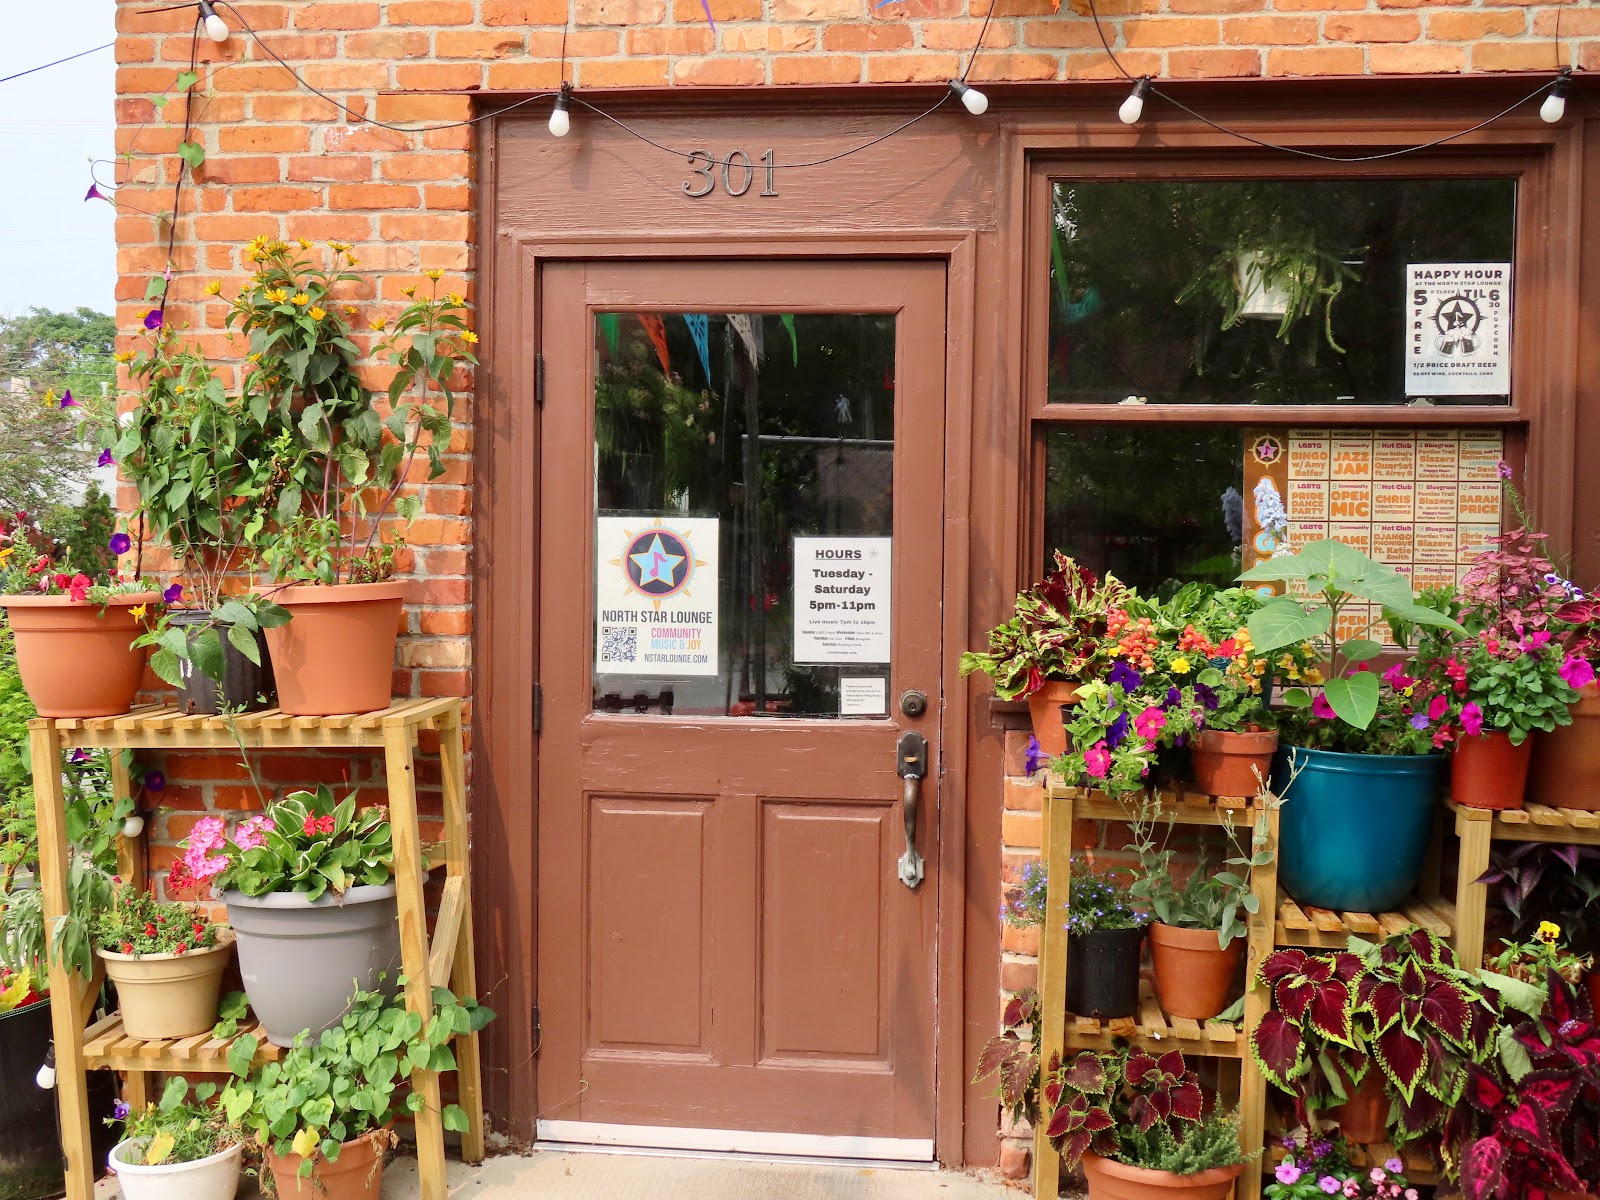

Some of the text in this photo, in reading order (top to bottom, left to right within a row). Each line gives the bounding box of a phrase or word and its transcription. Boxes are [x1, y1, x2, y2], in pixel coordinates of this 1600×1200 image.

[682, 148, 779, 197] 301
[1414, 270, 1502, 279] HAPPY HOUR
[1414, 290, 1427, 305] 5
[1464, 289, 1486, 298] TIL
[1489, 289, 1500, 301] 6
[1414, 310, 1422, 354] FREE
[1292, 452, 1328, 460] BINGO
[1334, 452, 1369, 462] JAZZ
[1334, 463, 1368, 475] JAM
[1292, 492, 1324, 500] PRIDE
[1331, 491, 1369, 500] OPEN
[1375, 494, 1411, 503] CHRIS
[1460, 495, 1498, 503] SARAH
[1331, 502, 1369, 517] MIC
[1460, 504, 1498, 514] PRICE
[1290, 533, 1324, 541] INTER
[815, 550, 862, 559] HOURS
[812, 569, 865, 580] Tuesday
[814, 585, 871, 596] Saturday
[809, 601, 875, 612] 5pm-11pm
[602, 610, 712, 624] NORTH STAR LOUNGE
[651, 628, 702, 639] COMMUNITY
[651, 639, 701, 650] MUSIC & JOY
[644, 654, 708, 663] NSTARLOUNGE.COM
